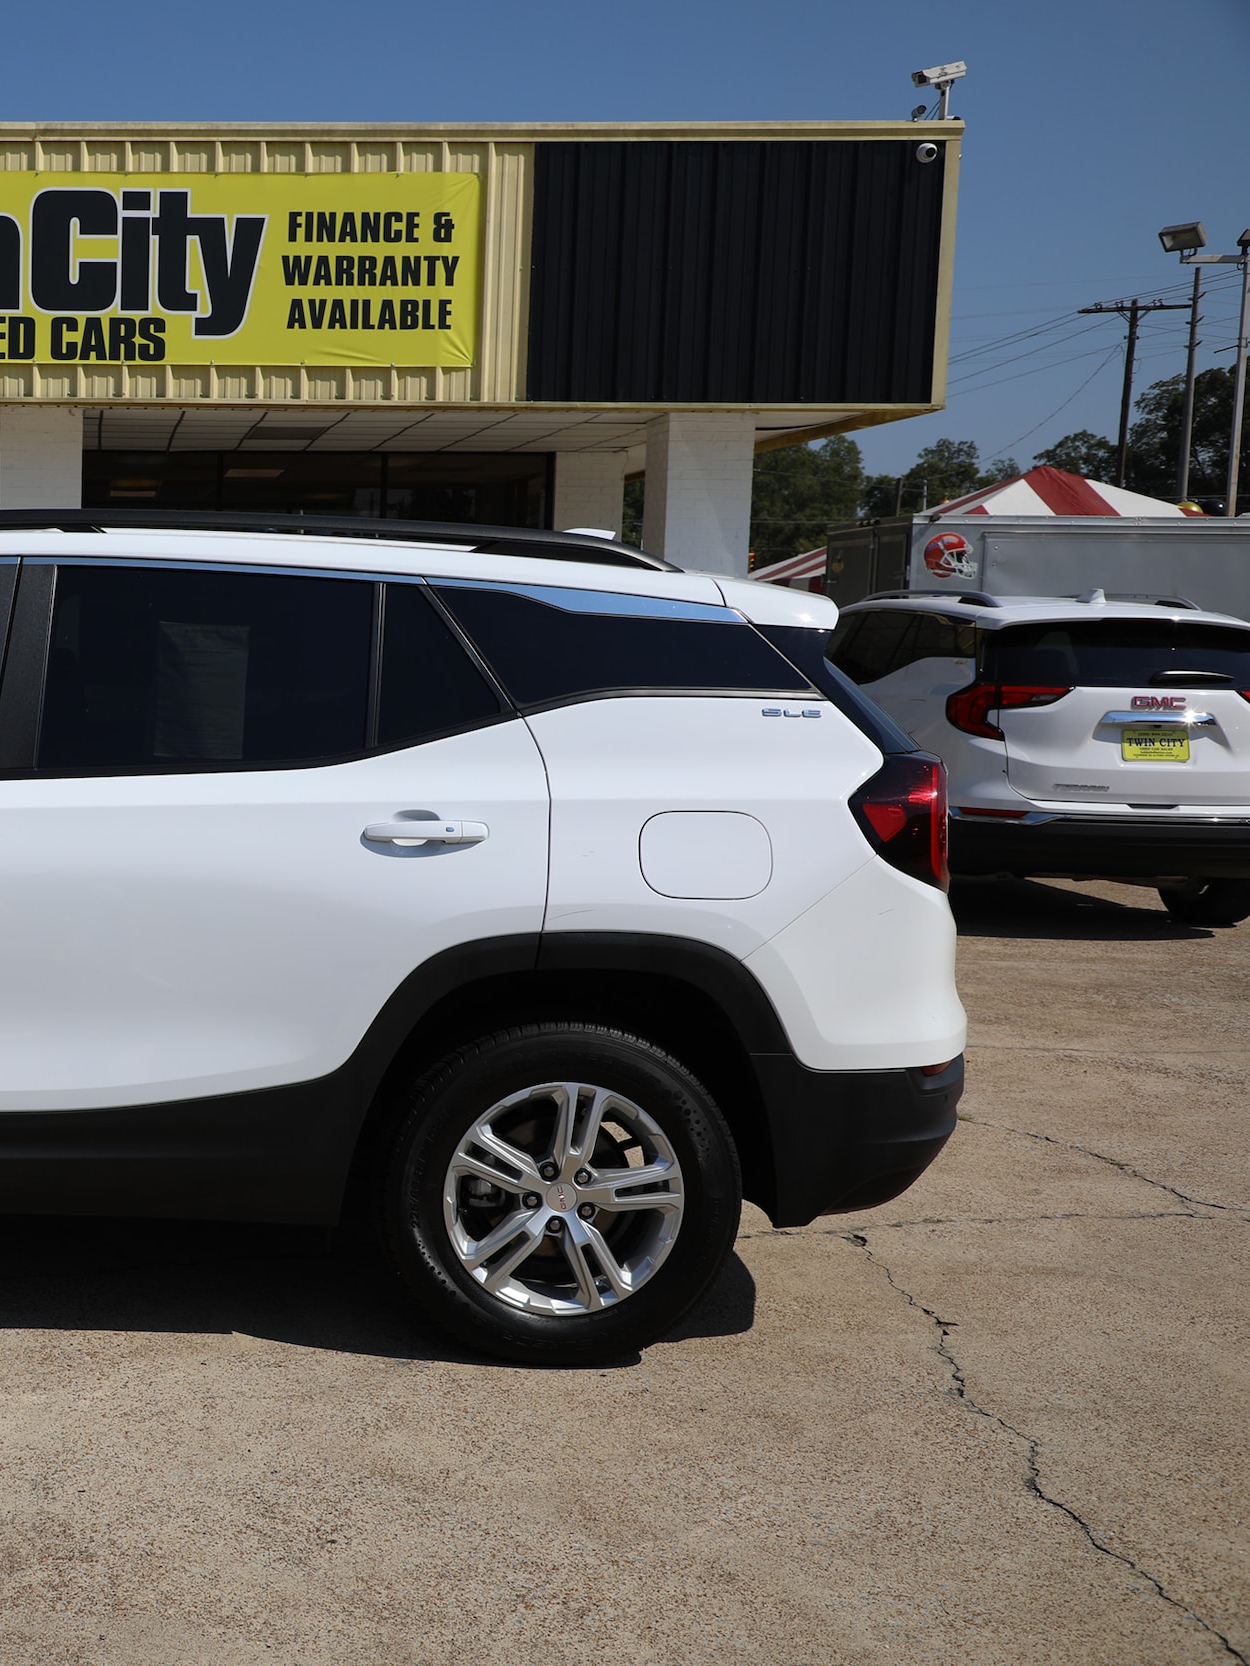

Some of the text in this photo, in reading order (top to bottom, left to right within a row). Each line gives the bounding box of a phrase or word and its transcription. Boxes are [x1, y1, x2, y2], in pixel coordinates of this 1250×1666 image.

[287, 211, 455, 243] FINANCE &
[281, 255, 460, 287] WARRANTY
[286, 298, 452, 330] AVAILABLE
[50, 316, 166, 361] CARS
[761, 708, 822, 719] SLE
[1130, 696, 1187, 710] GMC
[1126, 737, 1186, 747] TWIN CITY
